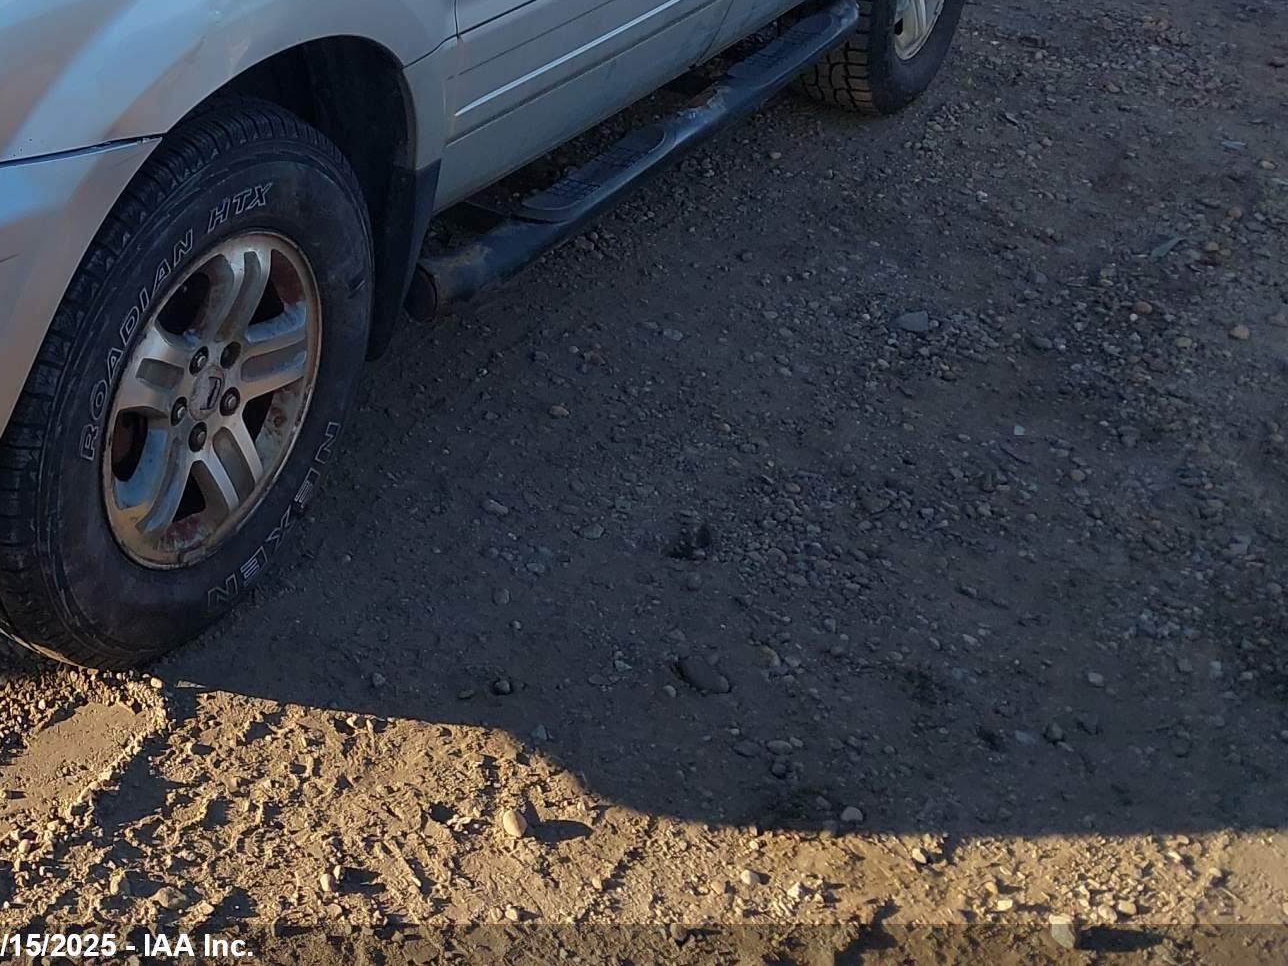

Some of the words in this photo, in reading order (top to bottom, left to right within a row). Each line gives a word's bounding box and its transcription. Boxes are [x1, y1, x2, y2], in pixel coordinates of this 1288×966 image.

[207, 183, 273, 233] HTX
[80, 228, 194, 462] ROADIAN
[207, 420, 342, 608] NEXEN
